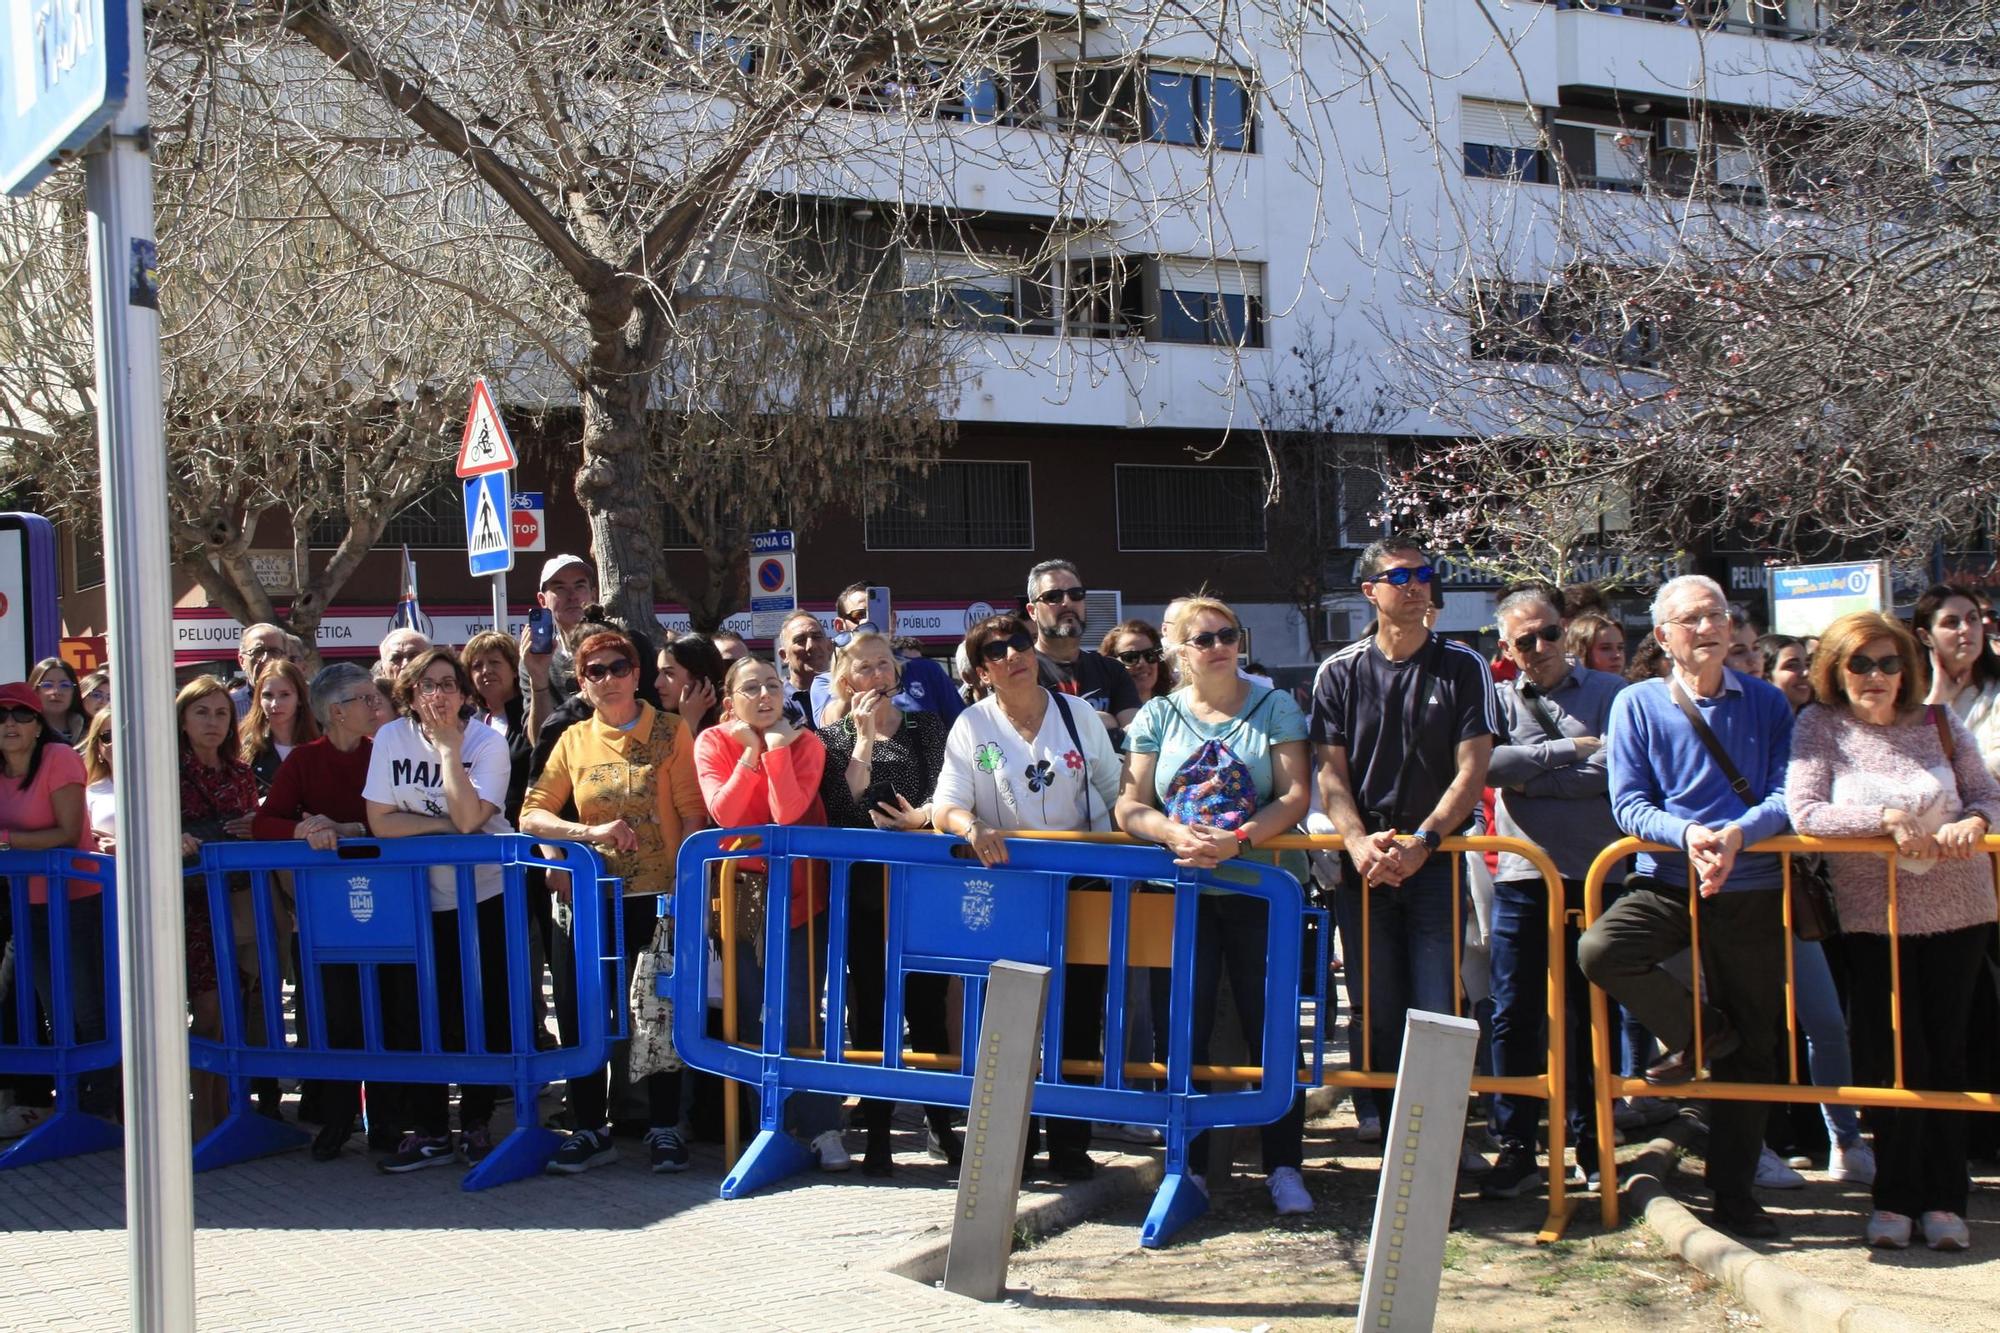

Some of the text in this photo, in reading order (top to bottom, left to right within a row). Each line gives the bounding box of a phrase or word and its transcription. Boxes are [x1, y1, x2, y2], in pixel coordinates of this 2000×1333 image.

[513, 524, 537, 534] TOP
[781, 535, 790, 546] G
[465, 623, 494, 636] VENT
[903, 615, 941, 629] PÚBLICO
